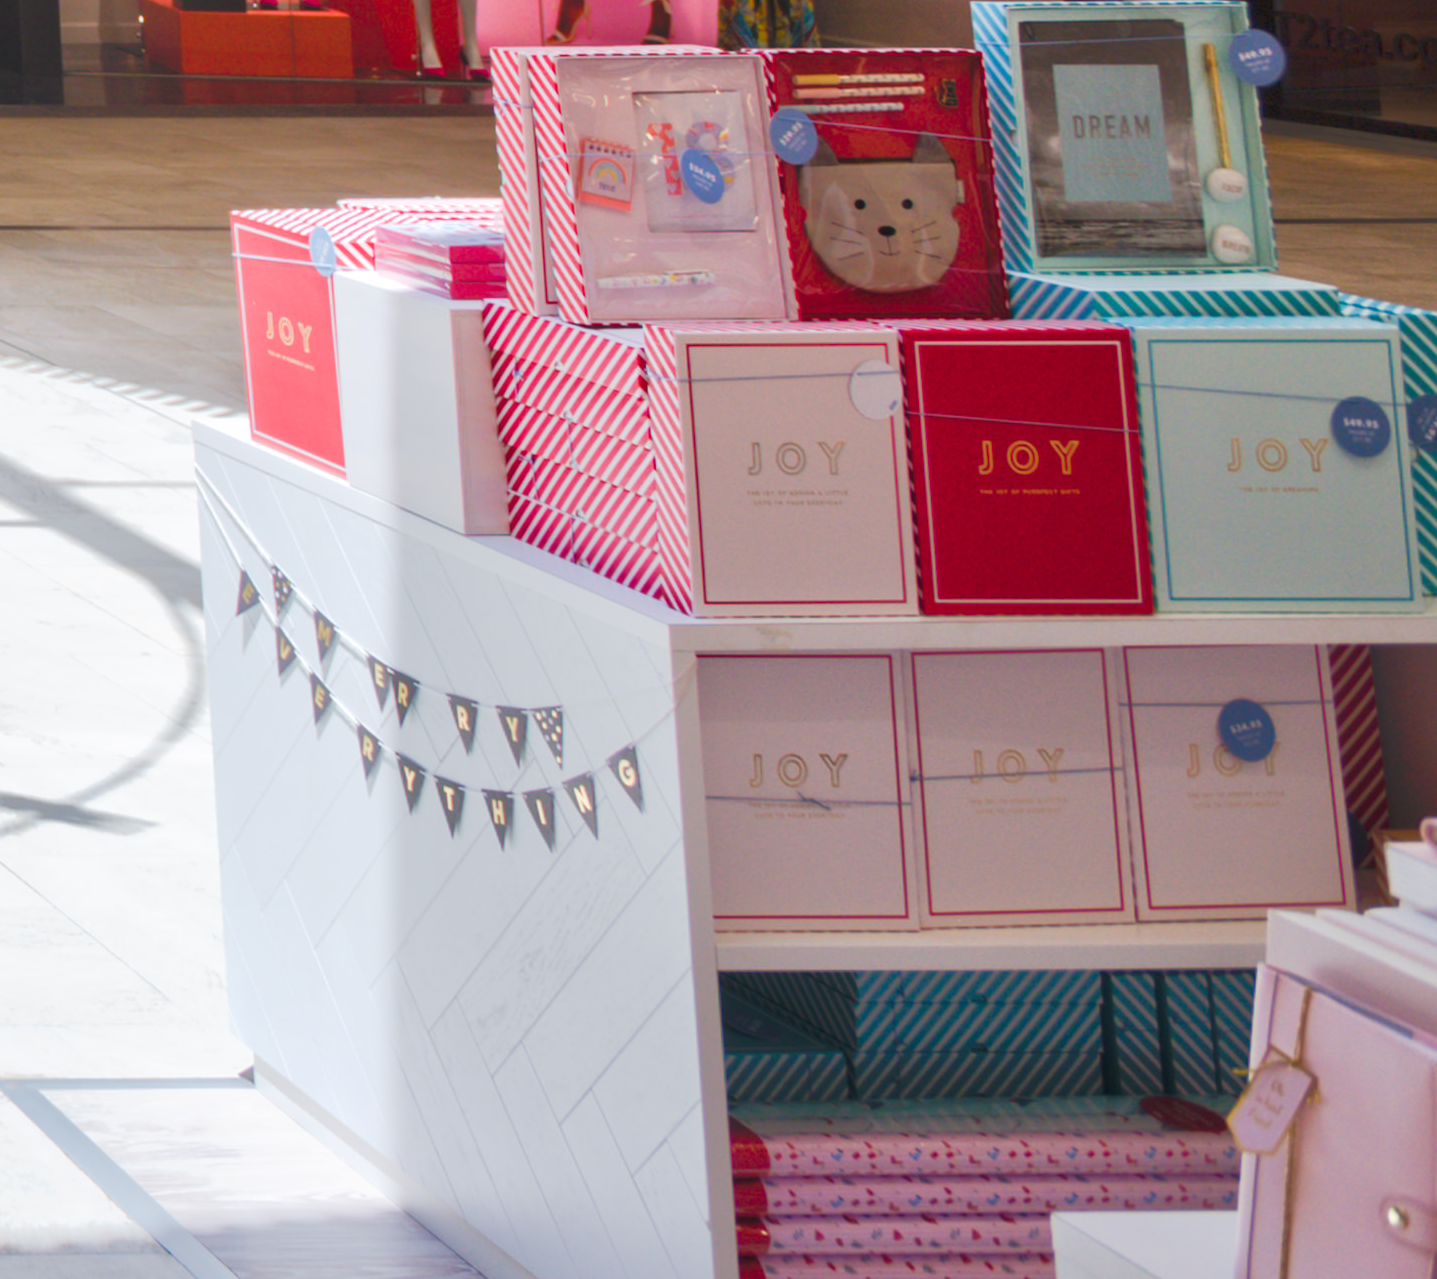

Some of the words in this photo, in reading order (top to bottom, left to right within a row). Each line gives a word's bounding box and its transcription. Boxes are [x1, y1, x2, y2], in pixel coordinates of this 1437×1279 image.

[1073, 114, 1151, 139] DREAM
[266, 311, 312, 353] JOY
[748, 441, 846, 476] JOY
[978, 440, 1080, 475] JOY
[1227, 438, 1329, 473] JOY
[318, 619, 519, 741] MERRY
[749, 753, 848, 788] JOY
[970, 748, 1065, 784] JOY
